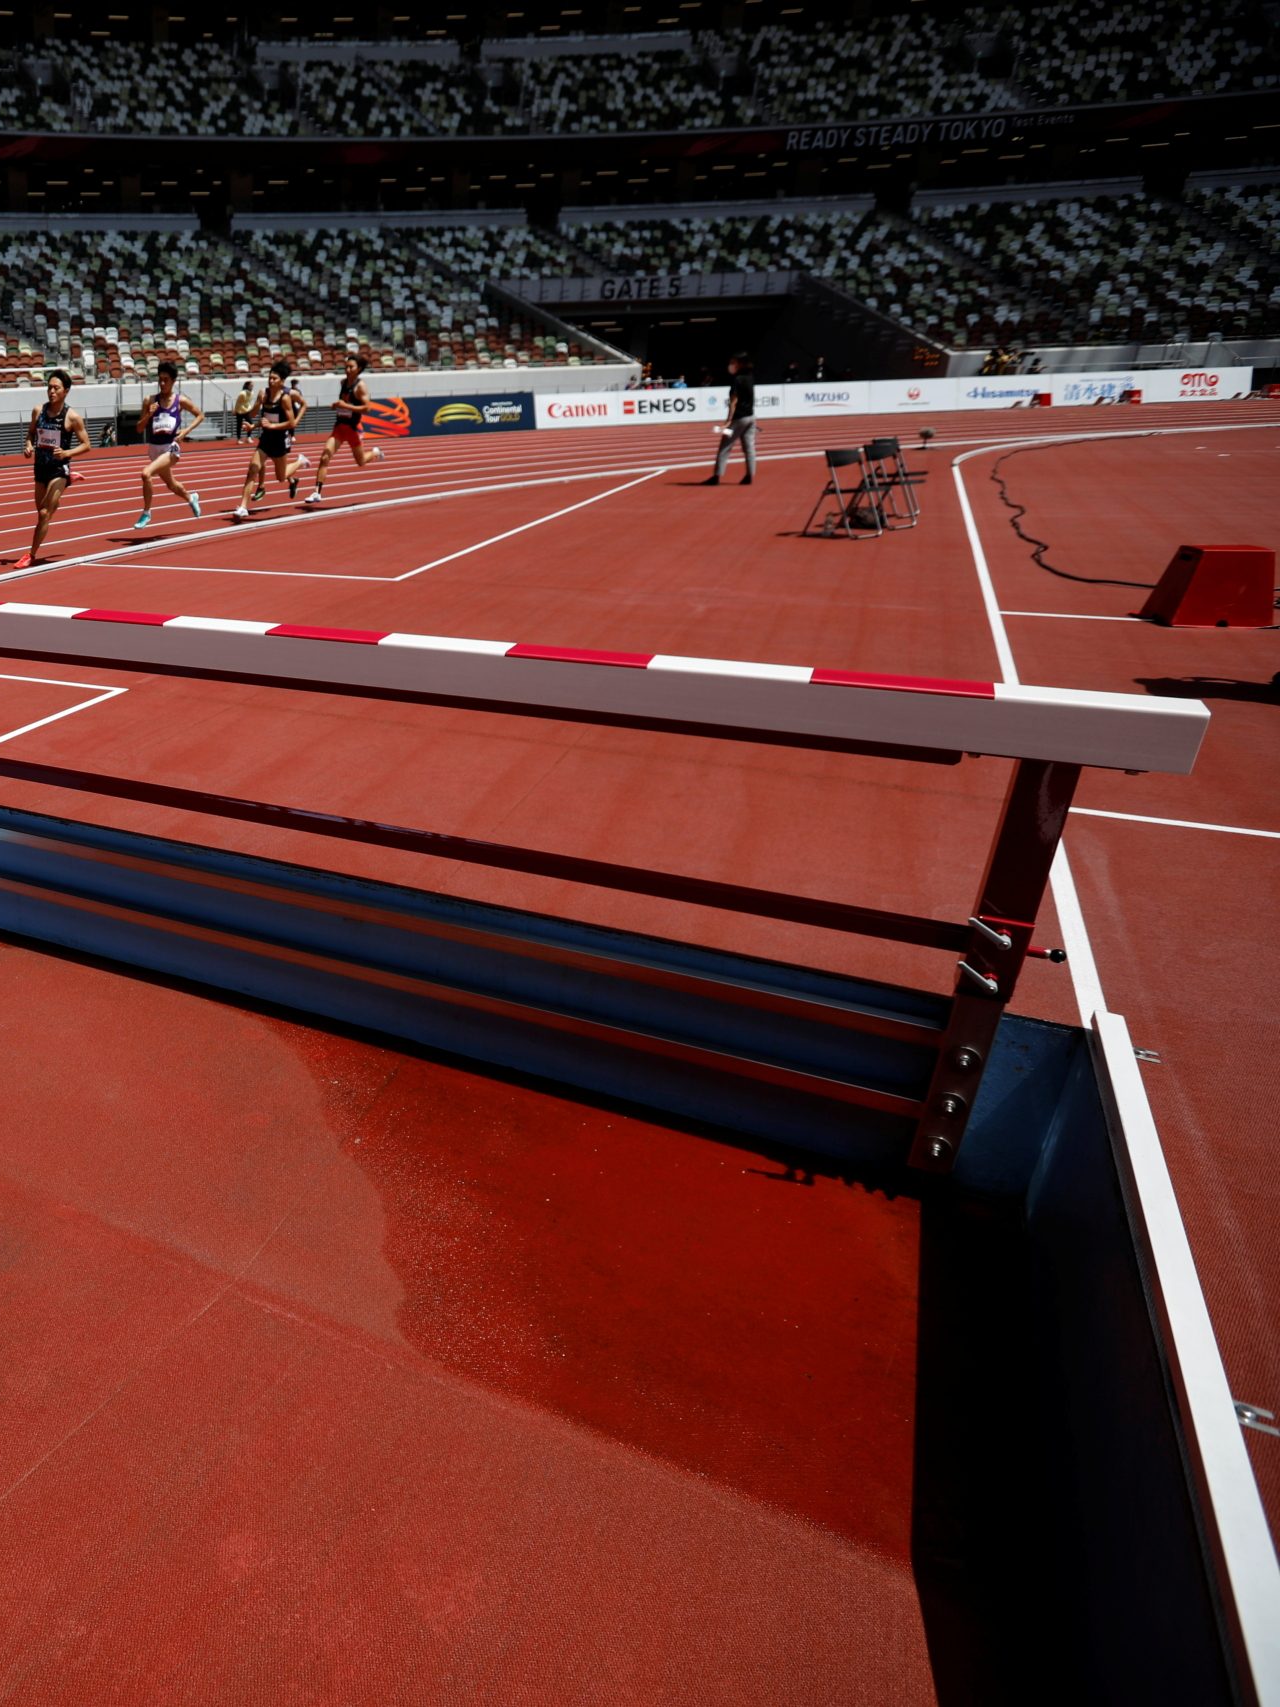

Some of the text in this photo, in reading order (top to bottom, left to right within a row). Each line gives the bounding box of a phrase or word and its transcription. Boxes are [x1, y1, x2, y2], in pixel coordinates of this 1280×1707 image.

[786, 128, 852, 151] READY
[853, 122, 935, 147] STEADY
[937, 117, 1007, 142] TOKYO
[600, 278, 681, 299] GATE 5
[637, 397, 697, 414] ENEOS
[805, 392, 851, 403] MIZUHO
[482, 405, 523, 415] Continental
[547, 401, 609, 419] Canon
[485, 414, 500, 424] Tour
